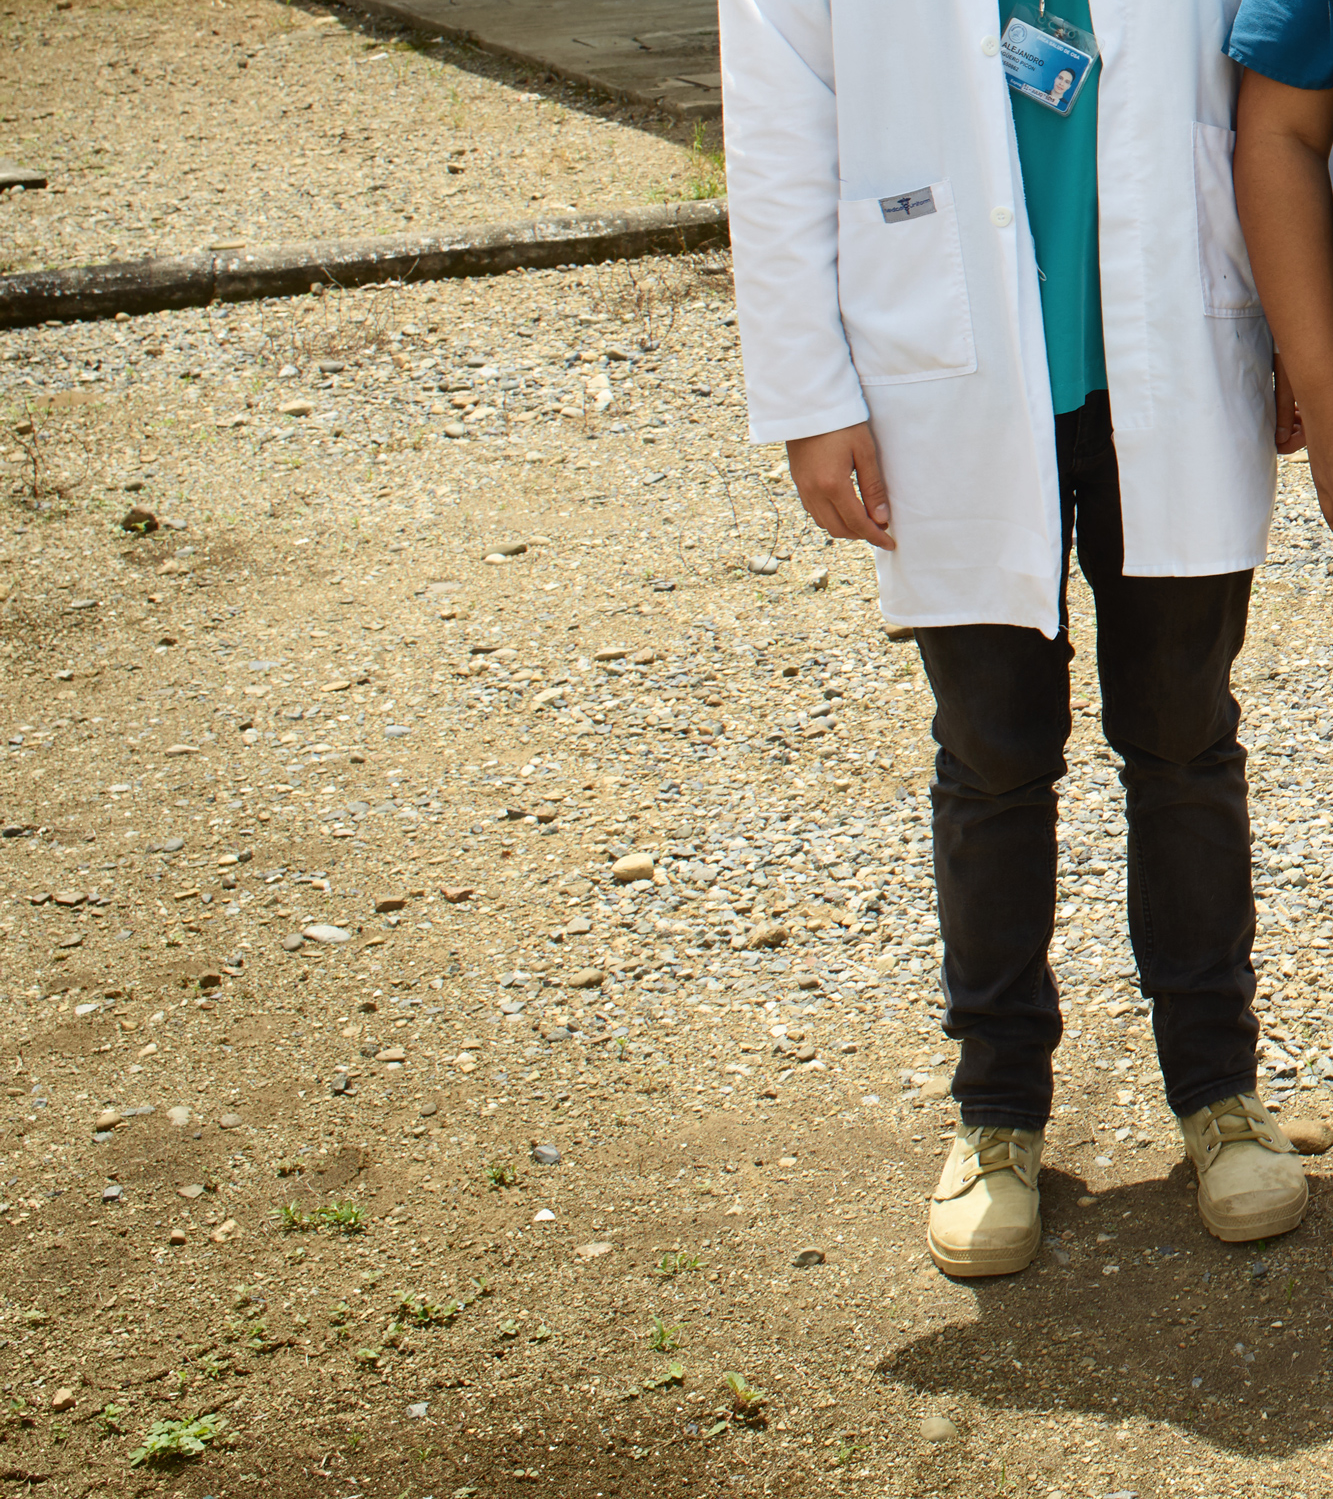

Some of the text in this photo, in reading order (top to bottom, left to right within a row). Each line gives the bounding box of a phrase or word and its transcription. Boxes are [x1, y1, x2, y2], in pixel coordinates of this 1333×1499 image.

[1001, 41, 1045, 67] ALEJANDRO
[1063, 47, 1071, 55] DE
[1070, 50, 1080, 60] OSA
